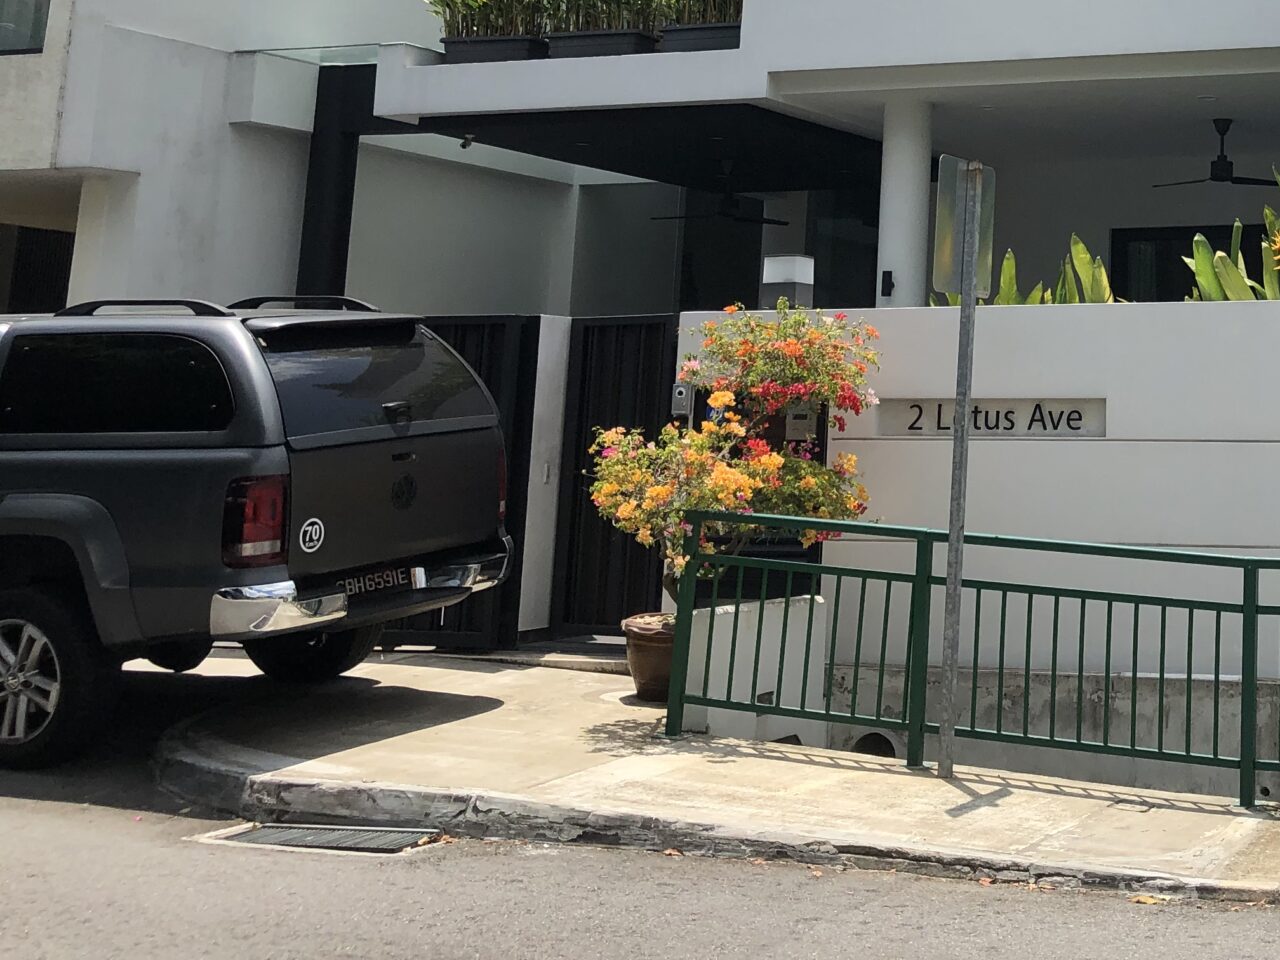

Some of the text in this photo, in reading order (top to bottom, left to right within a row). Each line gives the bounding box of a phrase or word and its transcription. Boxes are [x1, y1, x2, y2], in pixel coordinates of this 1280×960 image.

[908, 403, 1083, 431] 2 Ltus Ave
[305, 525, 320, 541] 70
